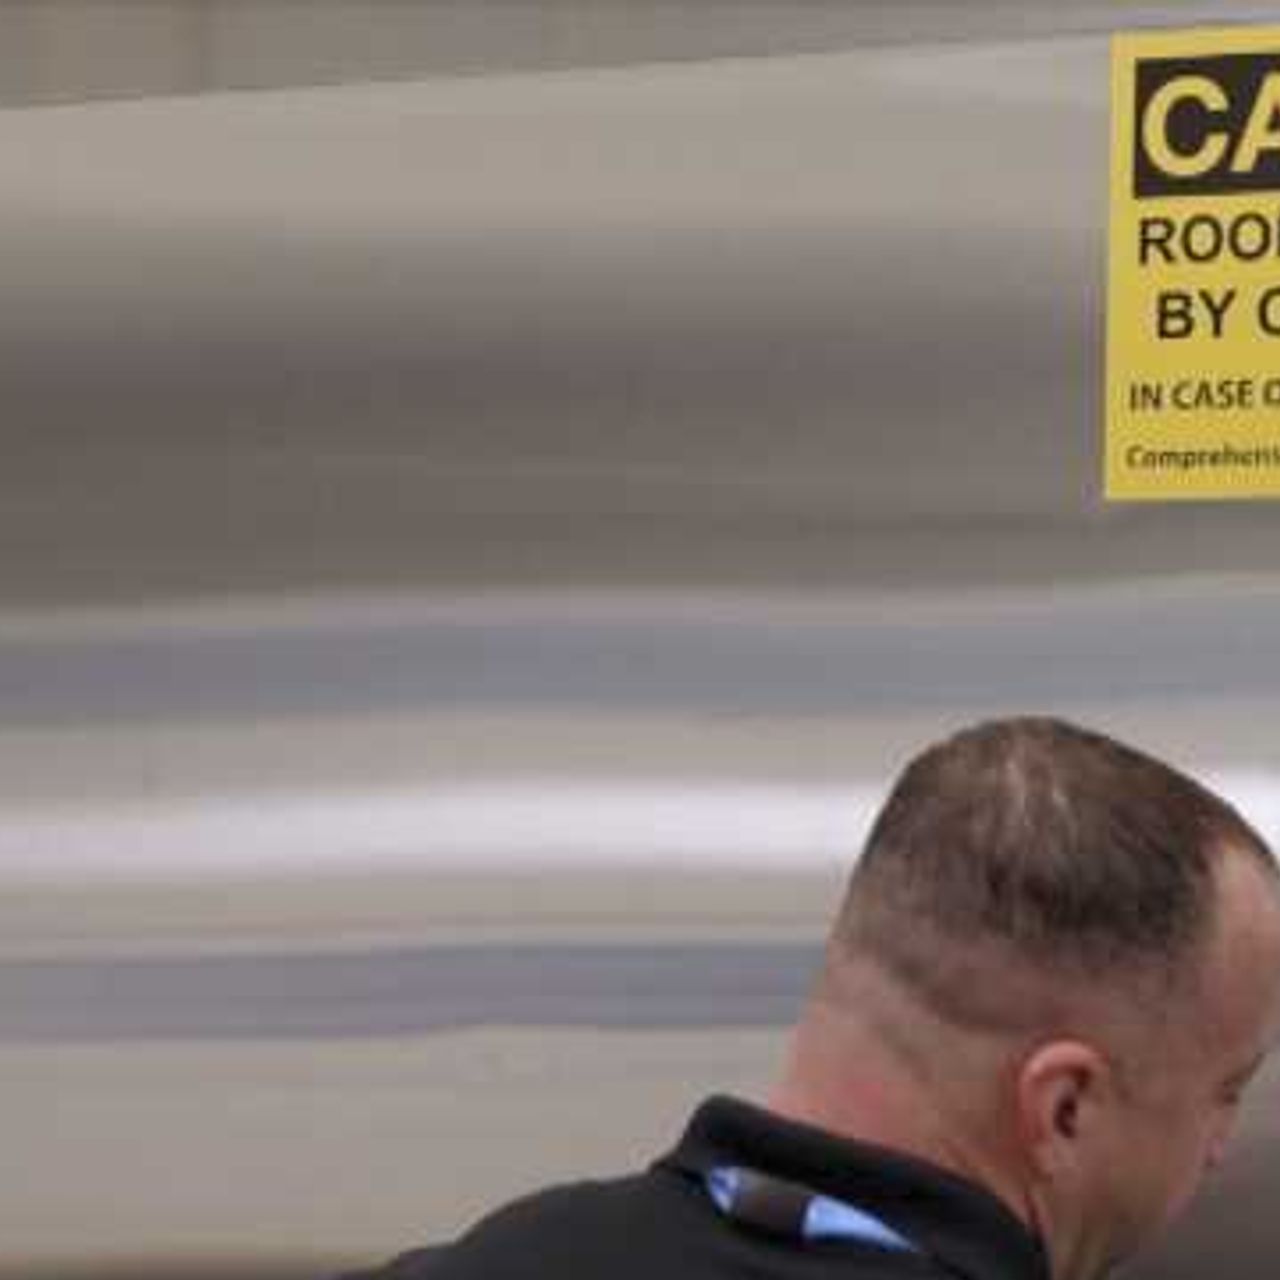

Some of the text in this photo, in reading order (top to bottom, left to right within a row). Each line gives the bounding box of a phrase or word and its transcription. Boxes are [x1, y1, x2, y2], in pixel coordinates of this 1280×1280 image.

[1157, 288, 1235, 340] BY
[1130, 381, 1163, 411] IN
[1171, 379, 1254, 410] CASE
